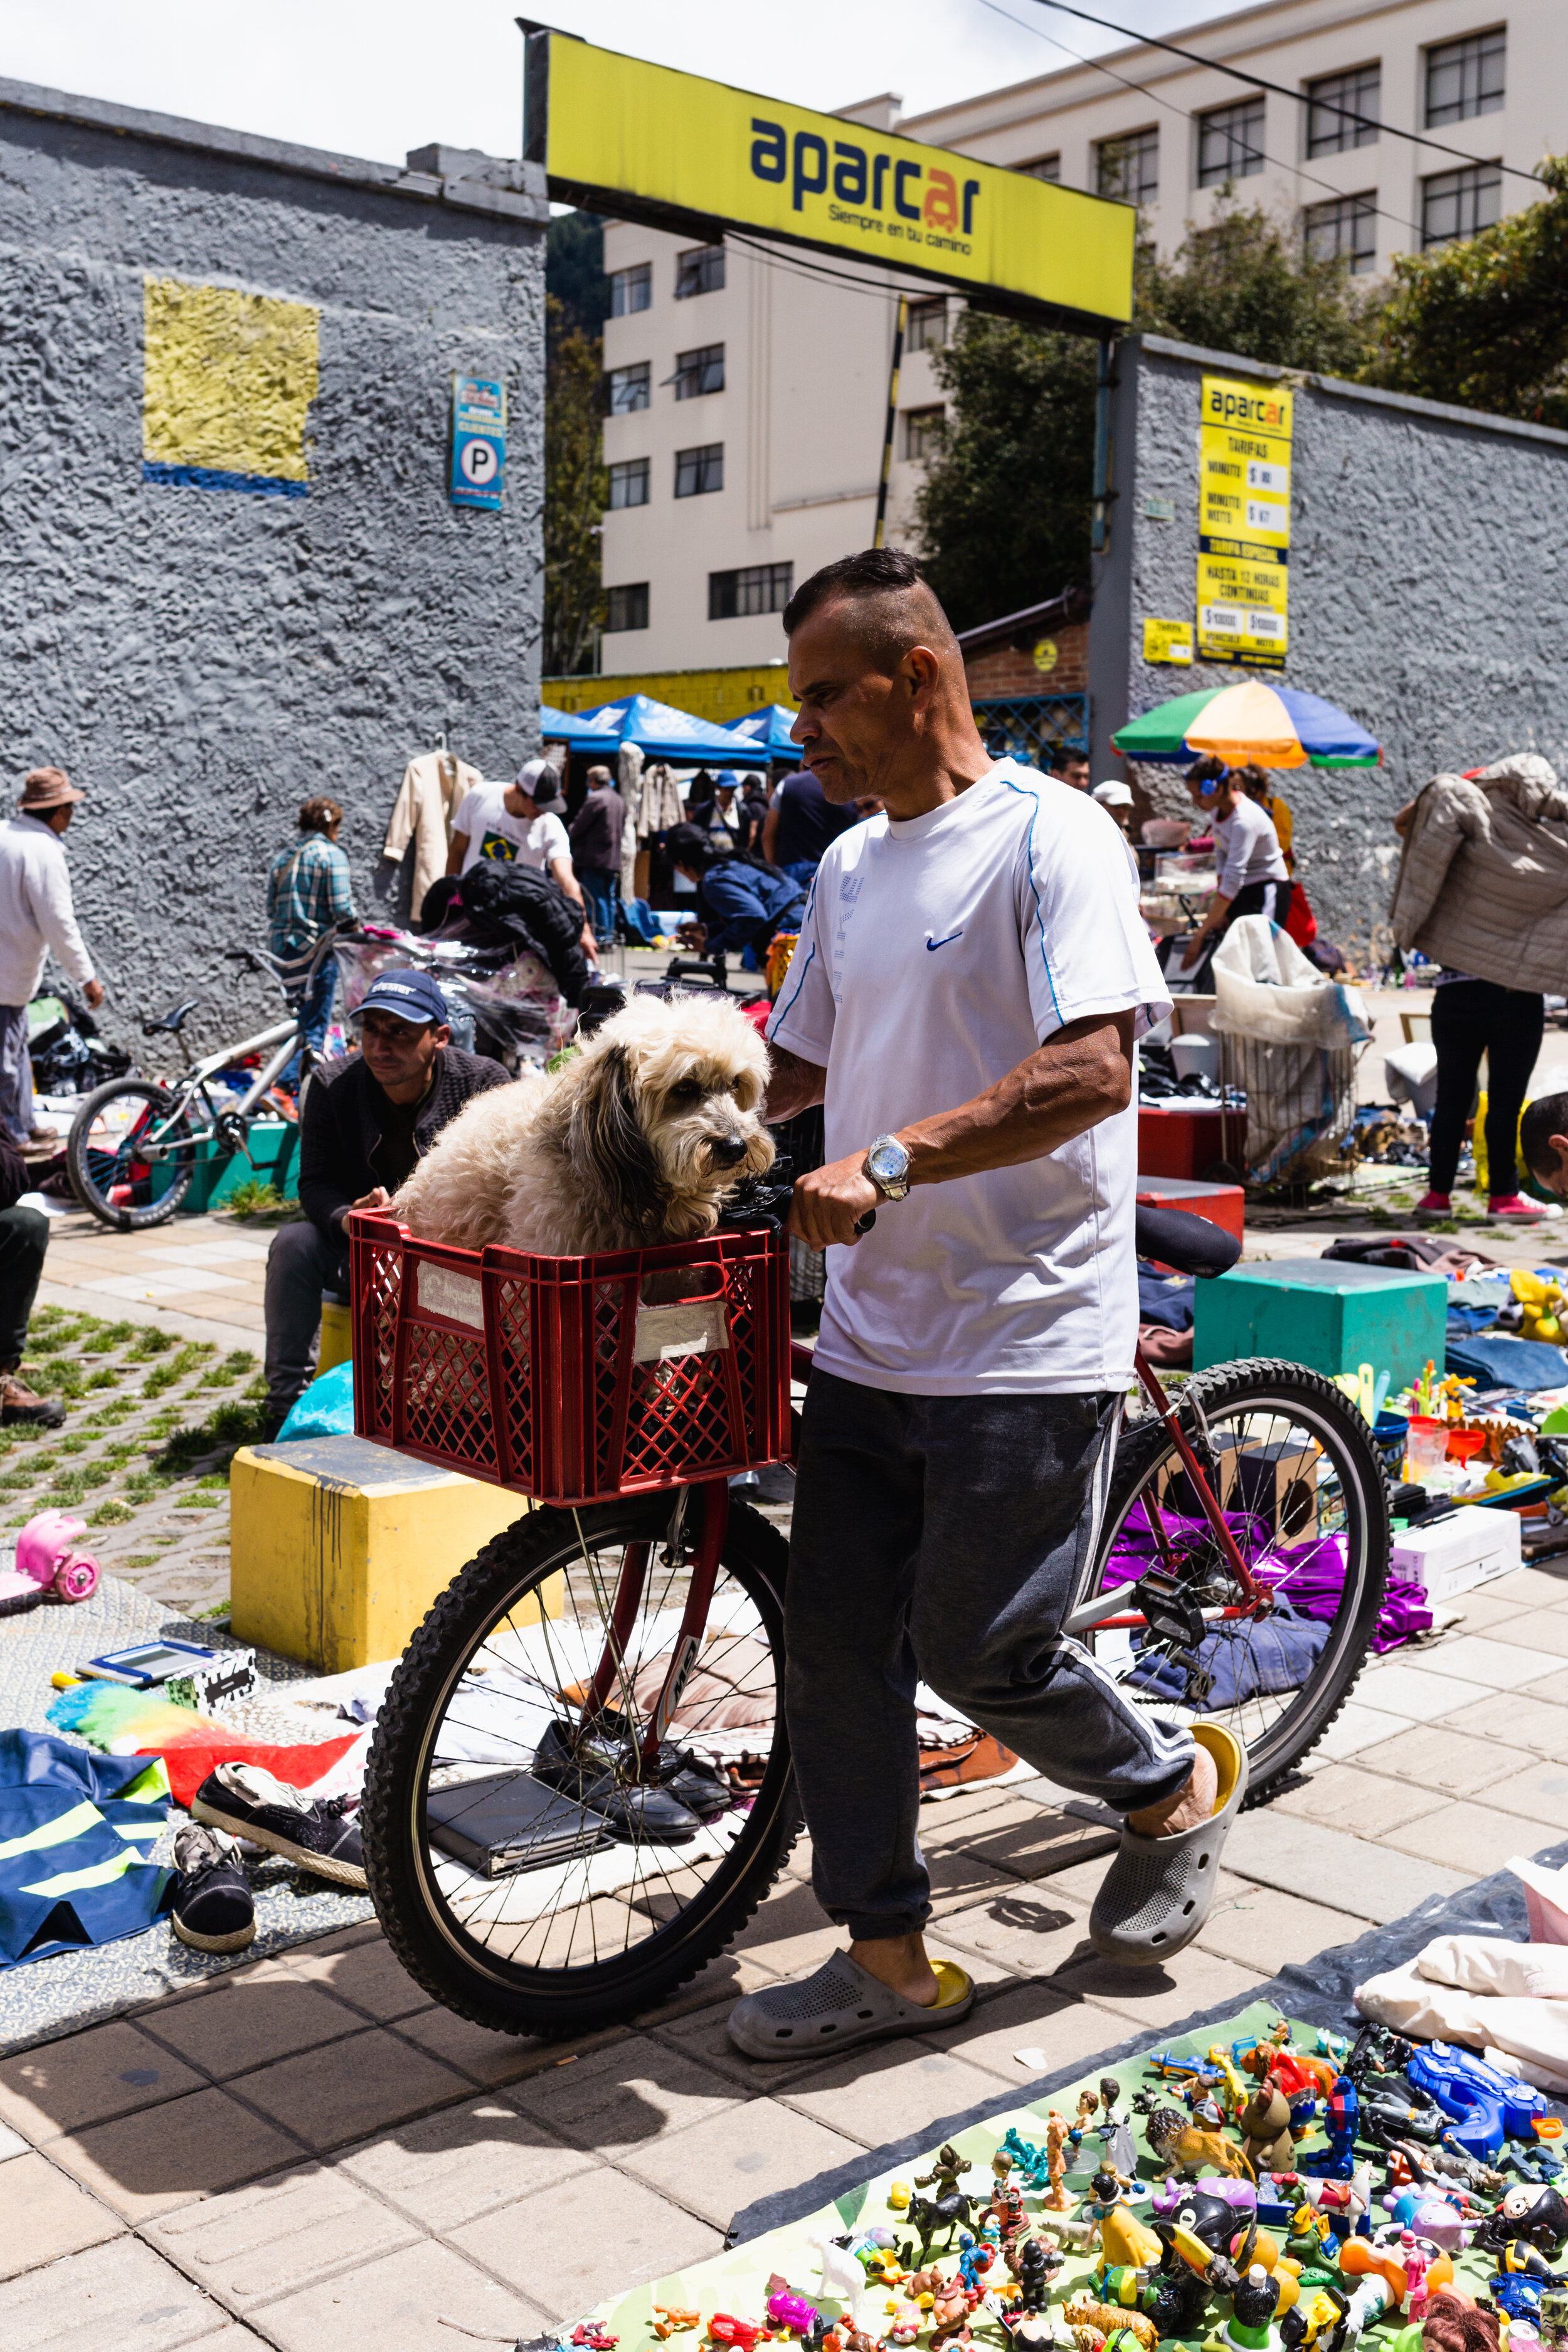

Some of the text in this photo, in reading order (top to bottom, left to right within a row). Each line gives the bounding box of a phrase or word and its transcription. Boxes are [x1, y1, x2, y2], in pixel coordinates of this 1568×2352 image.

[750, 117, 980, 235] aparcar
[828, 204, 972, 255] Siempre en tu camino
[1212, 391, 1284, 425] aparcar
[1228, 436, 1268, 458] TARIFAS
[472, 447, 489, 475] P
[1208, 460, 1241, 479] MINUTO
[1207, 492, 1240, 509] MINUTO
[1207, 509, 1231, 524] MOTO
[1207, 566, 1279, 588] HASTA 12 HORAS
[1220, 584, 1269, 602] CONTINUAS
[674, 1640, 697, 1704] GW
